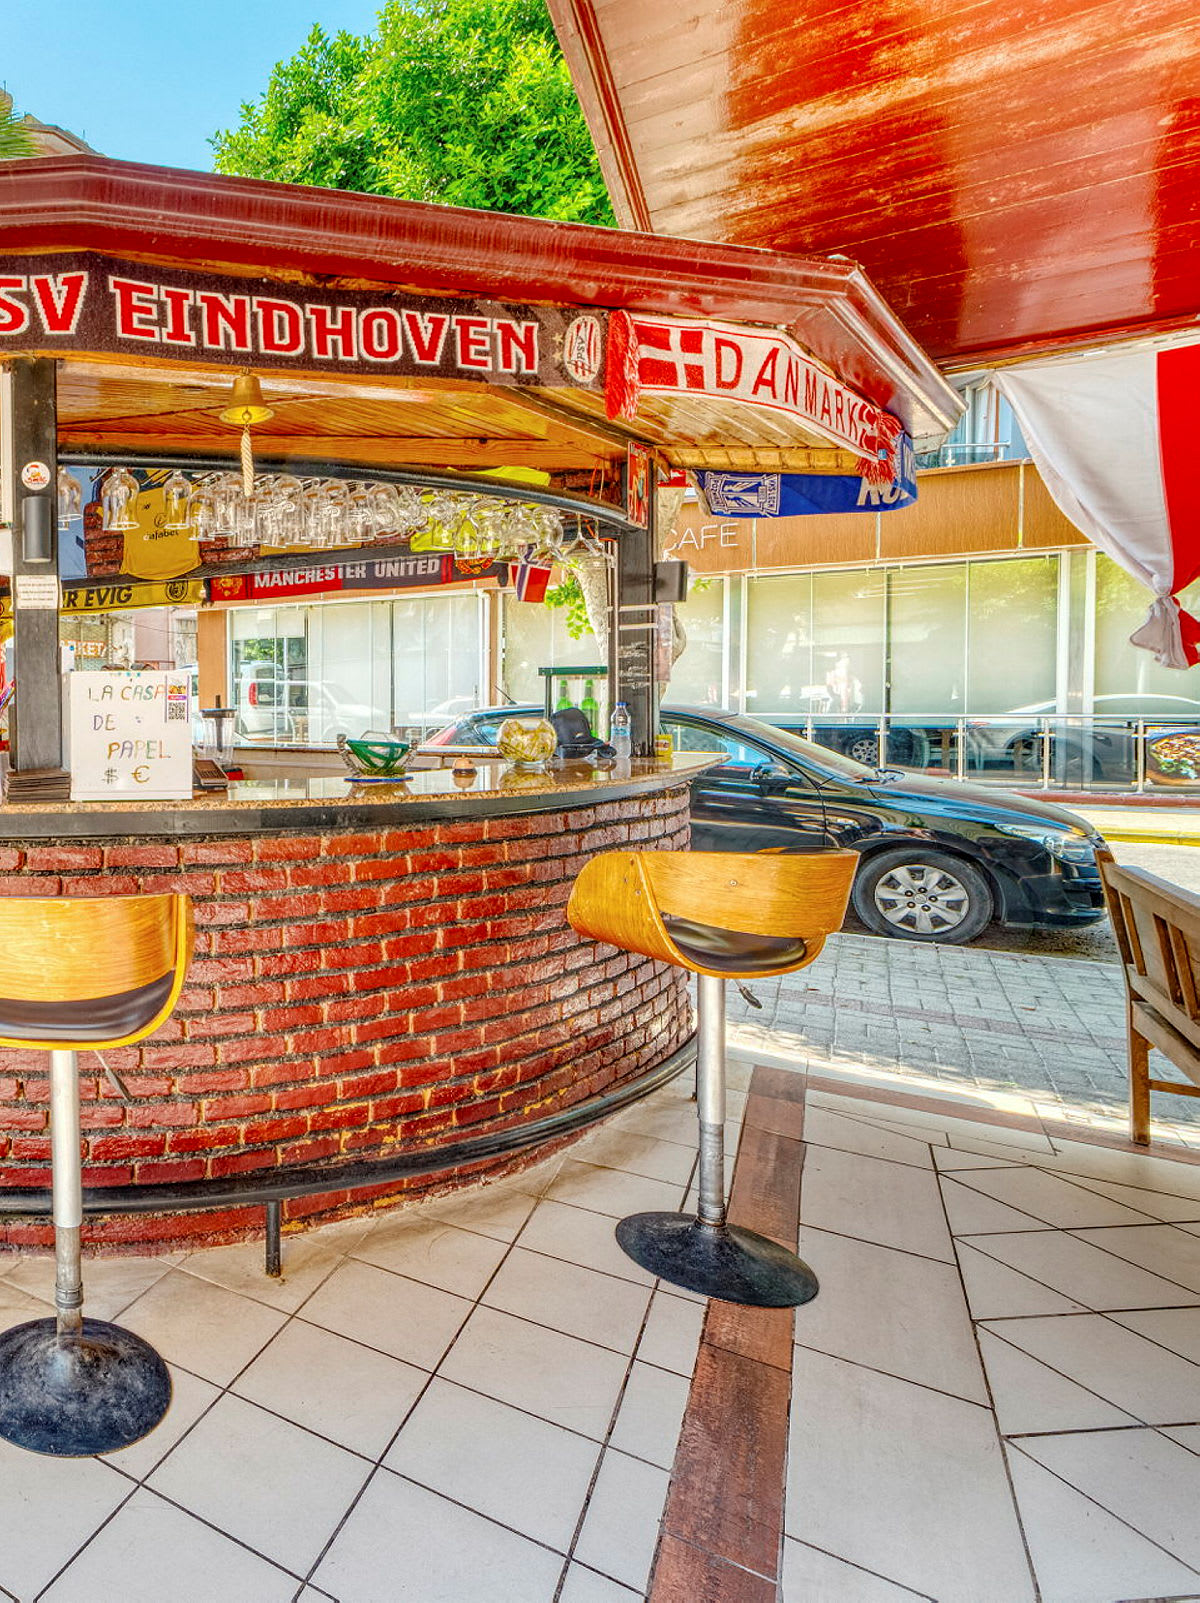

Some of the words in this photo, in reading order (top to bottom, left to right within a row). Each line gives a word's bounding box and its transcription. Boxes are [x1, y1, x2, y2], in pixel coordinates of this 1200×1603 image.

[108, 275, 541, 375] EINDHOVEN
[714, 337, 859, 441] DANMARK
[254, 564, 366, 588] MANCHESTER
[374, 558, 441, 578] UNITED
[84, 585, 133, 607] EVIG
[88, 684, 113, 701] LA
[93, 713, 116, 731] DE
[107, 739, 171, 760] PAPEL
